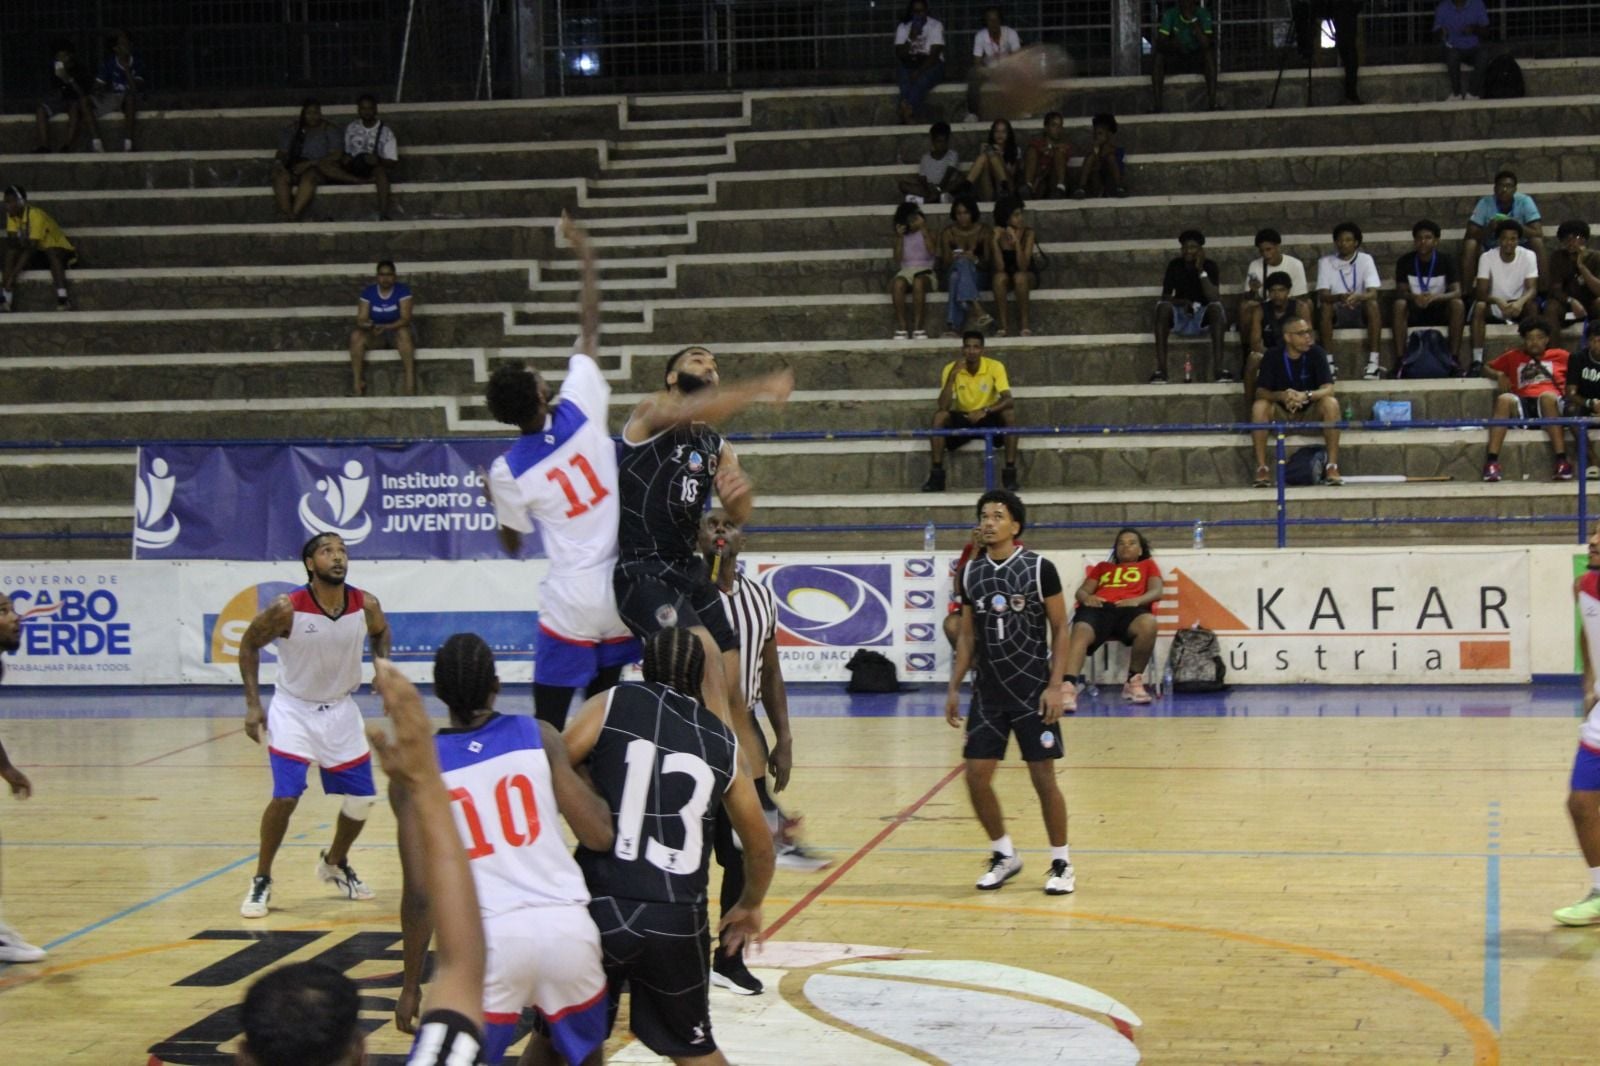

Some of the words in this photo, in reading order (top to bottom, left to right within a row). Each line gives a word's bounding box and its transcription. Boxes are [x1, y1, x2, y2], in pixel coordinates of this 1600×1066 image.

[382, 472, 458, 489] Instituto
[545, 452, 610, 518] 11
[680, 475, 699, 503] 10
[382, 493, 472, 509] DESPORTO
[476, 496, 487, 507] e
[4, 575, 86, 585] GOVERNO
[98, 575, 118, 585] DE
[9, 589, 118, 622] CABO
[1257, 586, 1510, 631] KAFAR
[996, 618, 1005, 640] 1
[7, 664, 64, 672] TRABALHAR
[67, 664, 93, 672] PARA
[449, 774, 541, 860] 10
[614, 738, 716, 875] 13
